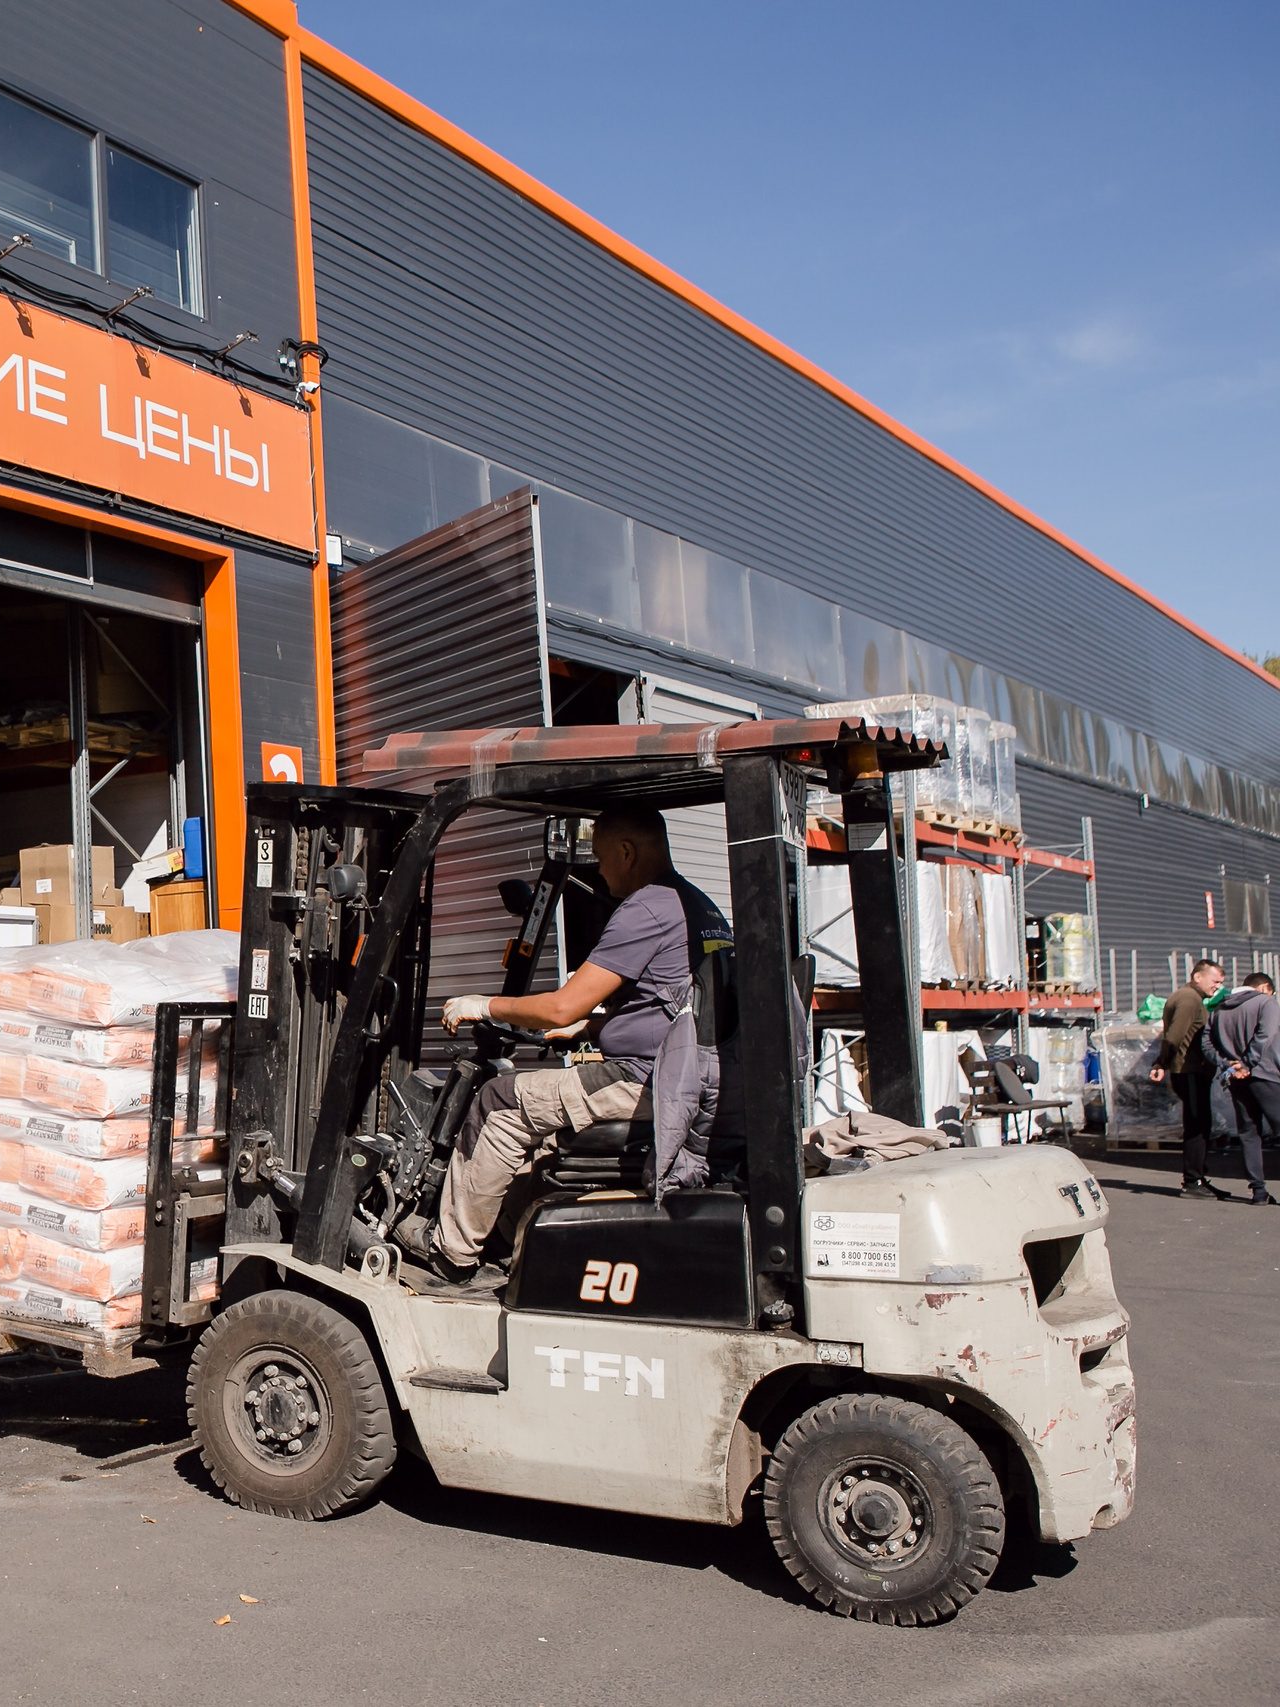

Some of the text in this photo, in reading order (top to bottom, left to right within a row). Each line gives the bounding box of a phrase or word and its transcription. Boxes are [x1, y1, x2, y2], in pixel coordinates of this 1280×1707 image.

[99, 383, 271, 493] ЦЕНЫ
[841, 1251, 896, 1261] 8 800 7000 651
[579, 1259, 639, 1305] 20
[533, 1345, 665, 1399] TFN
